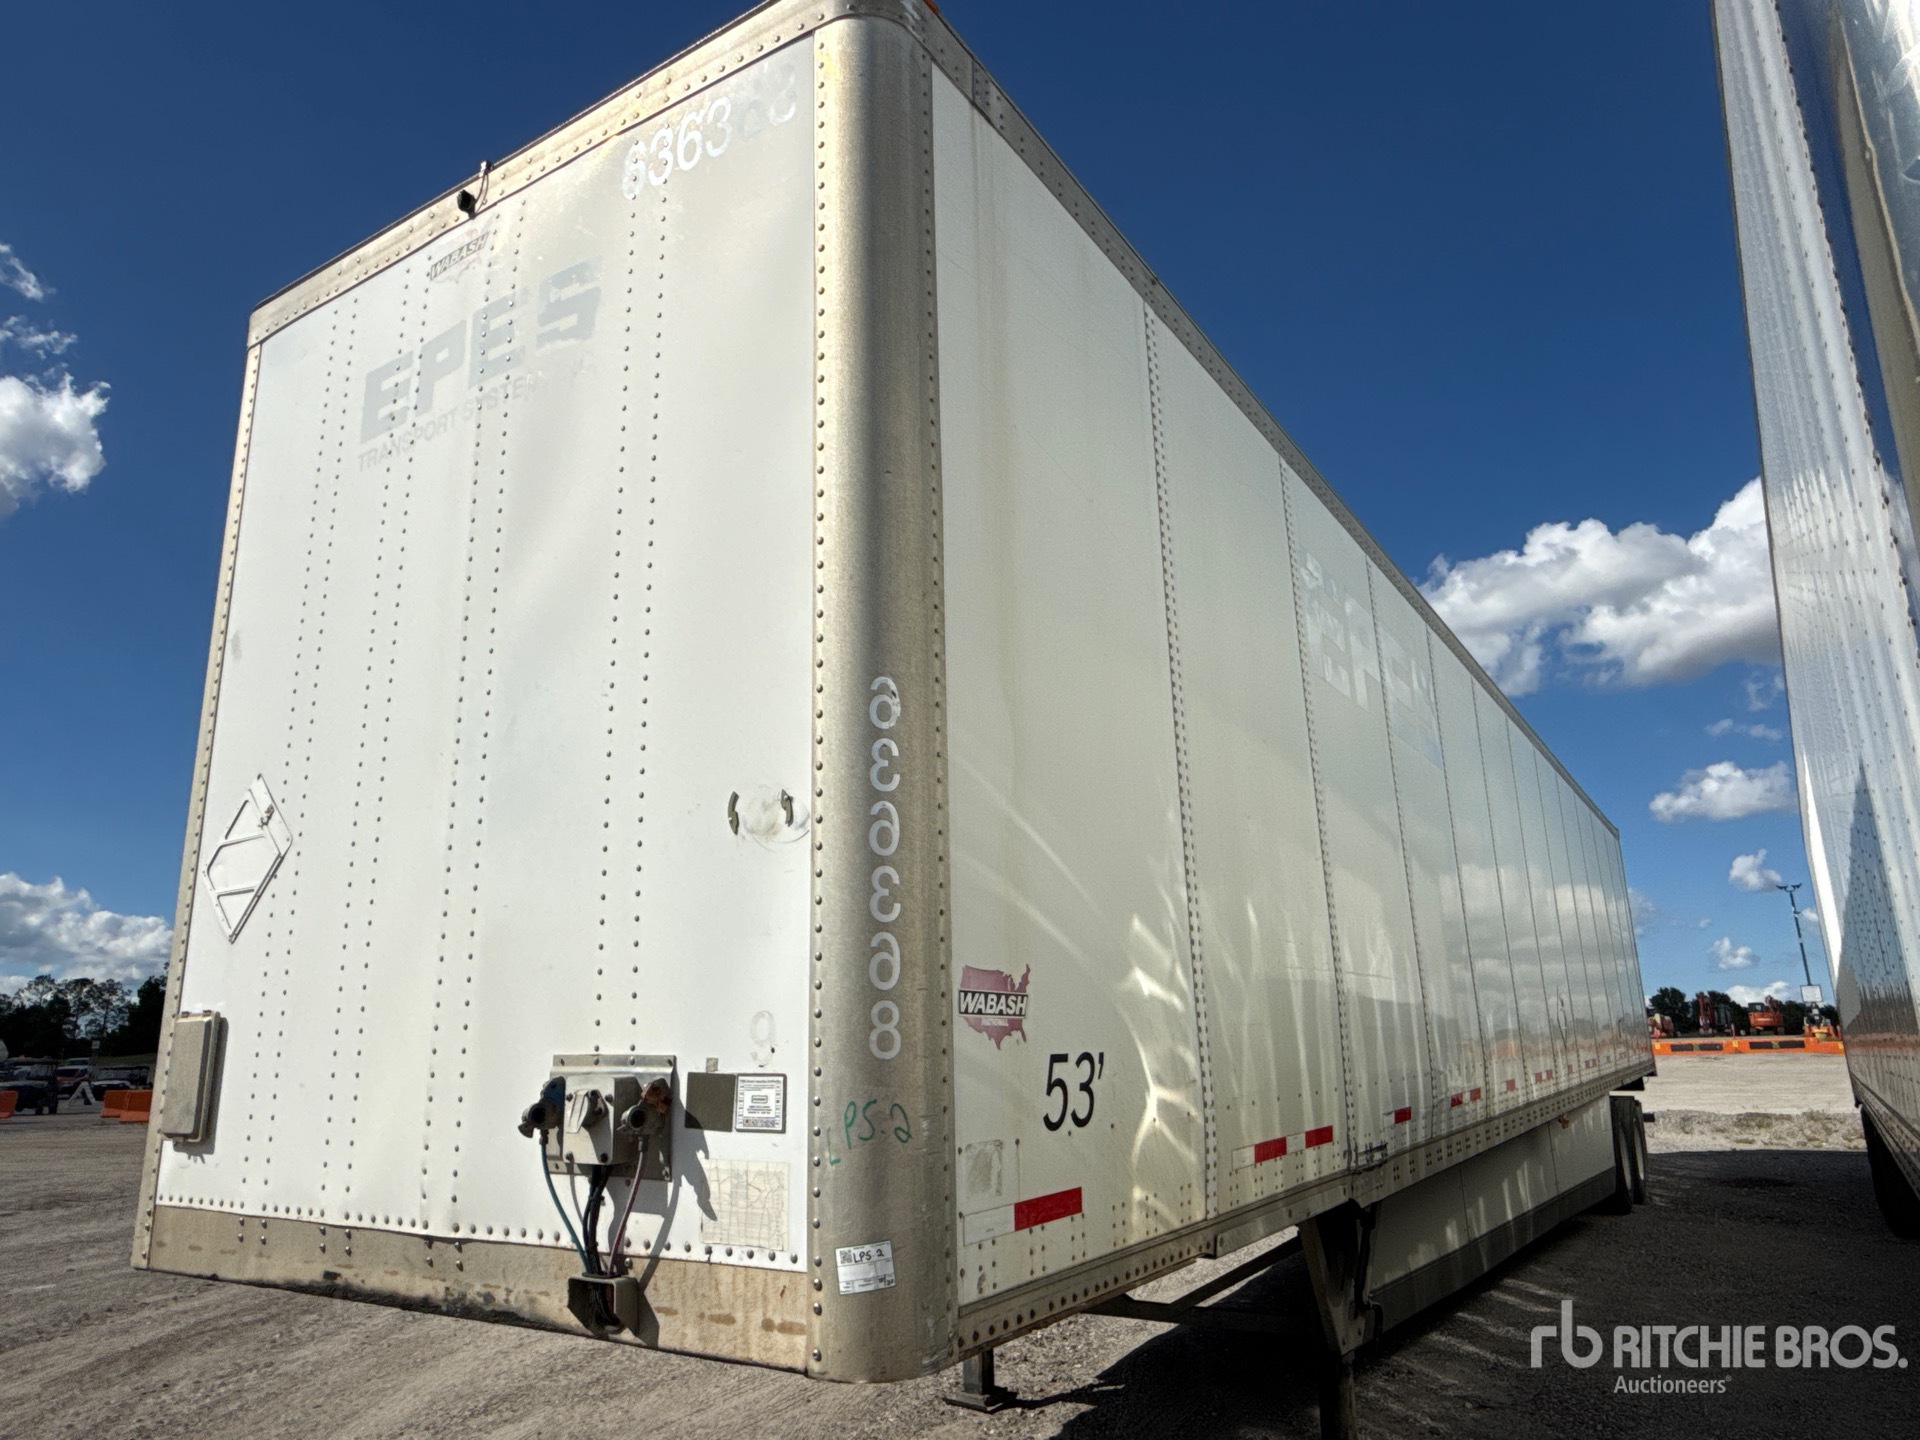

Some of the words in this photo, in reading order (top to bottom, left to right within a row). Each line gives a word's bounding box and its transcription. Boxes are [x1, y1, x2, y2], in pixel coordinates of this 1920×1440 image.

[431, 233, 488, 278] WABASH
[360, 254, 601, 444] EPES
[358, 405, 459, 472] TRANSPORT
[959, 991, 1028, 1015] WABASH
[1043, 1052, 1104, 1131] 53'
